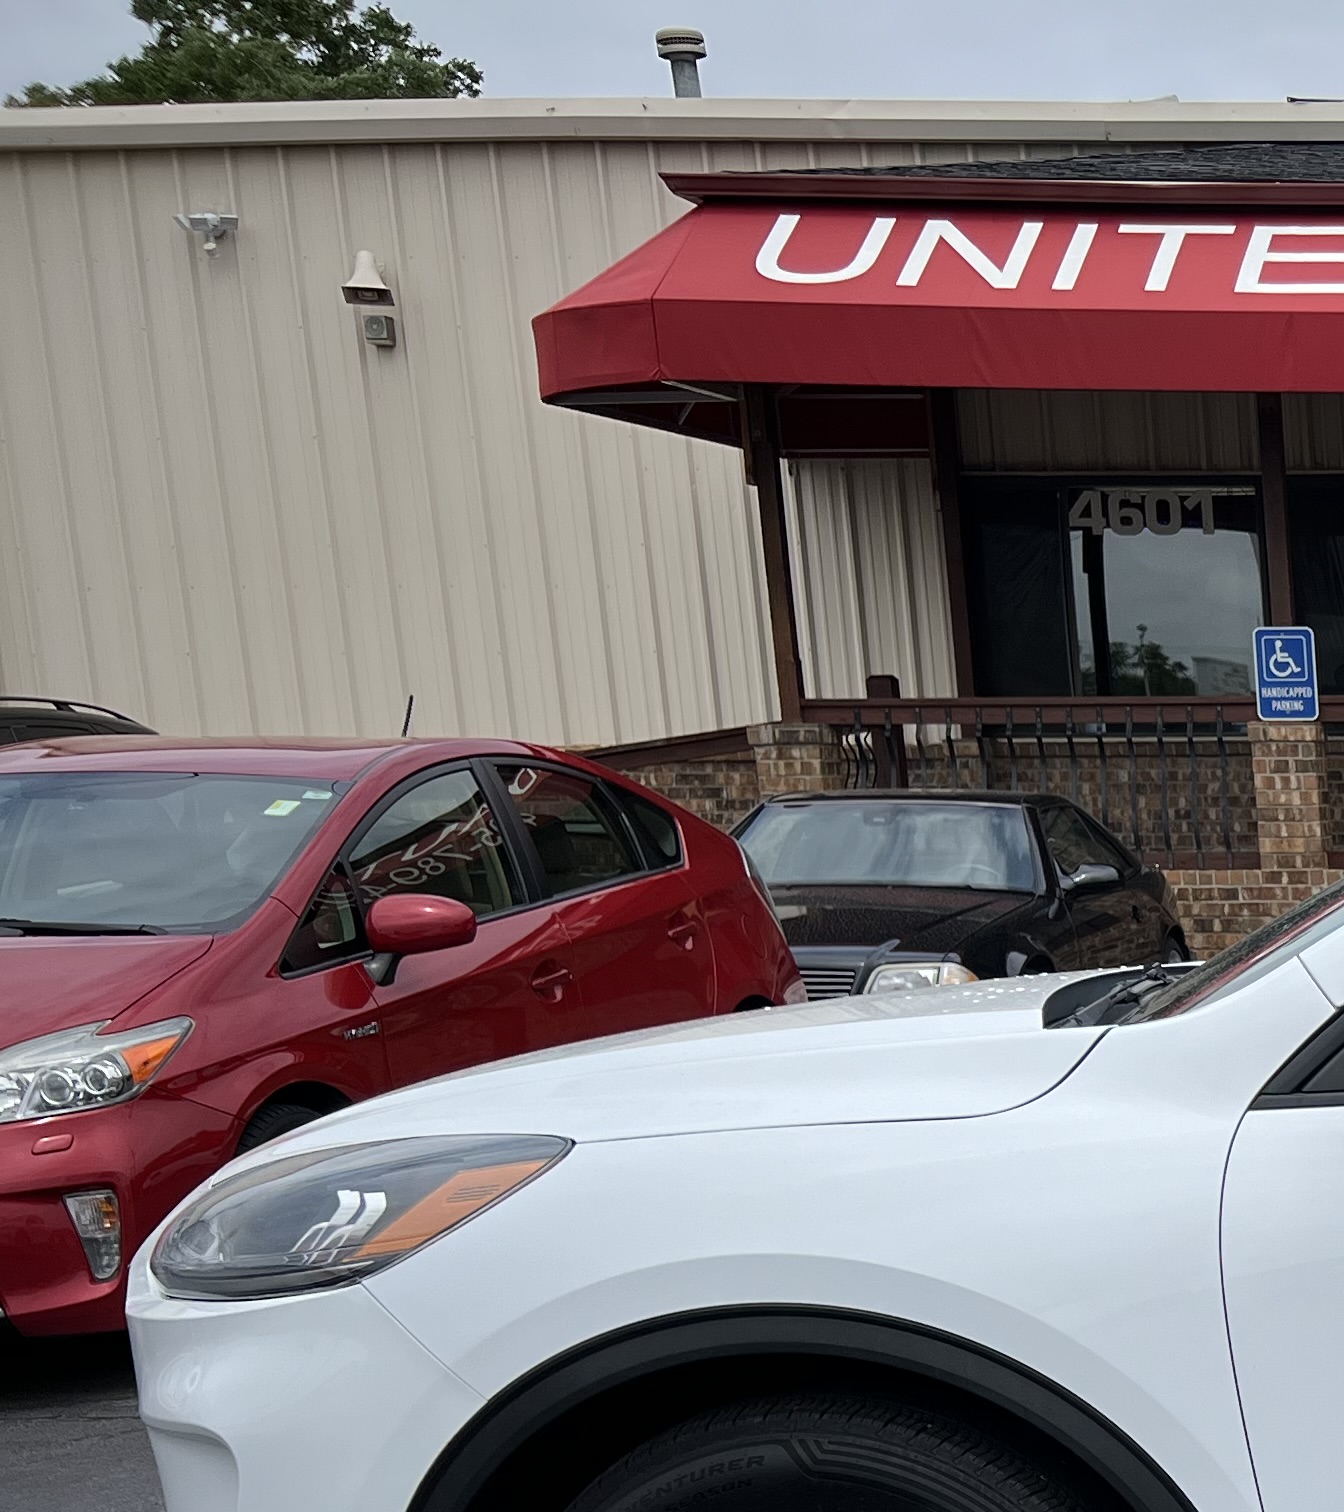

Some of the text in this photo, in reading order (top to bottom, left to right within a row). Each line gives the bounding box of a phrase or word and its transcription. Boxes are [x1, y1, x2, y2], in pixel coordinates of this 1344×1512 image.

[1069, 488, 1215, 535] 4601
[1261, 686, 1312, 698] HANDICAPPED
[1271, 700, 1304, 711] PARKING
